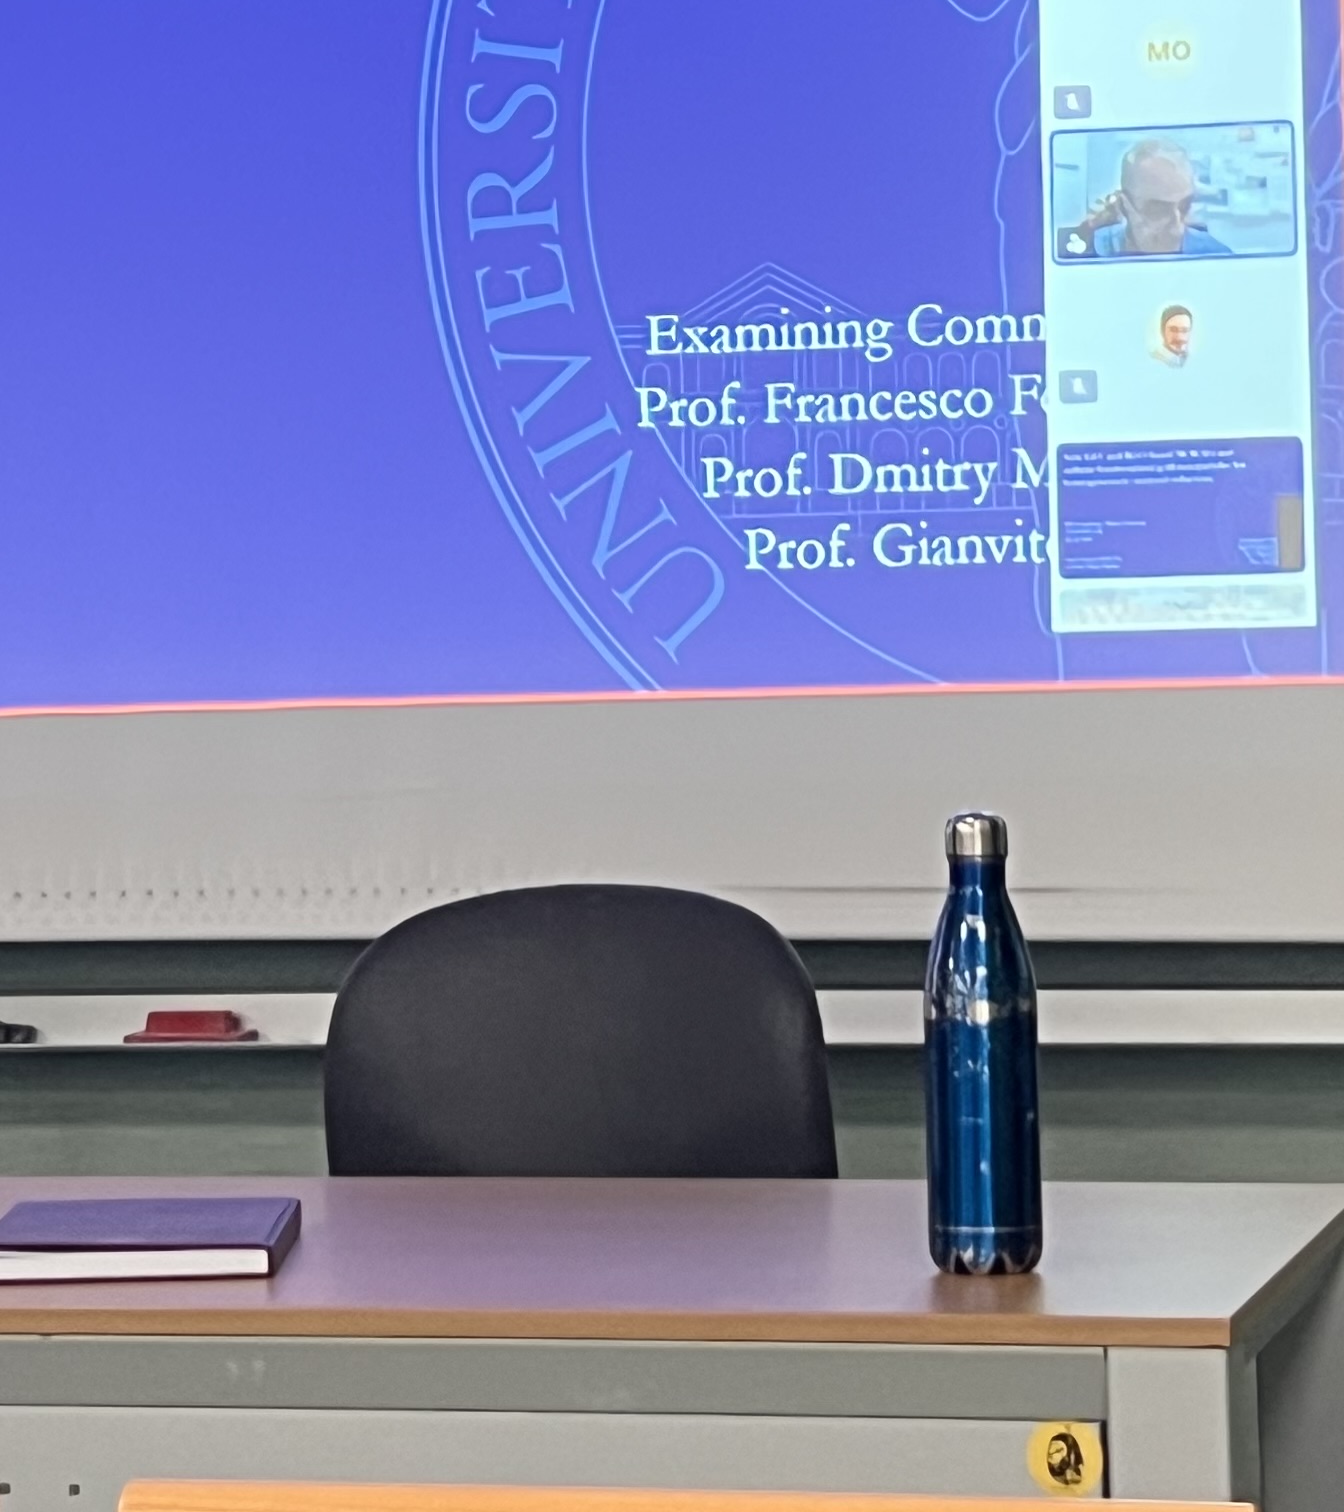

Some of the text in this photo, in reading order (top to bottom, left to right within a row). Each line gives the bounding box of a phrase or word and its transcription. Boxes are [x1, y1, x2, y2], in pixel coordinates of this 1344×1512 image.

[1147, 40, 1192, 63] MO
[646, 306, 894, 364] Examining
[636, 386, 746, 428] Prof.
[764, 381, 994, 423] Francesco
[701, 456, 813, 498] Prof.
[828, 447, 998, 505] Dmitry
[744, 519, 1050, 570] Prof. Gianvit
